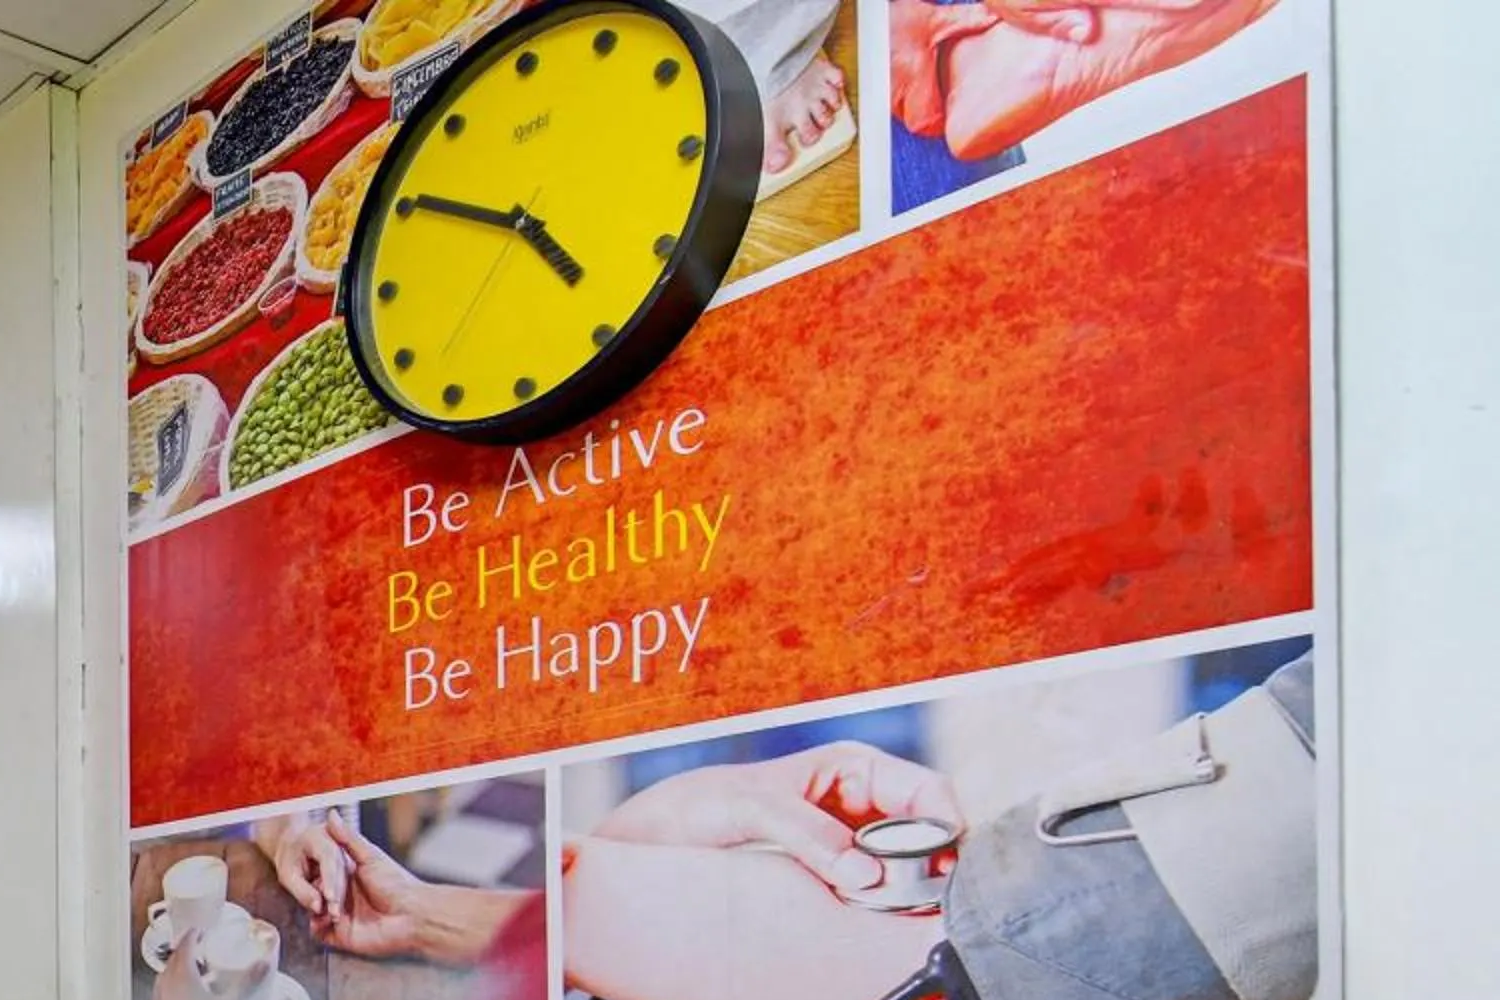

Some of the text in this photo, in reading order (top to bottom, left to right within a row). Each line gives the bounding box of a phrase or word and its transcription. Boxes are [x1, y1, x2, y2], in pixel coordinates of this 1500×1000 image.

[403, 406, 706, 549] Be Active
[388, 489, 731, 633] Be Healthy
[404, 597, 709, 711] Be Happy
